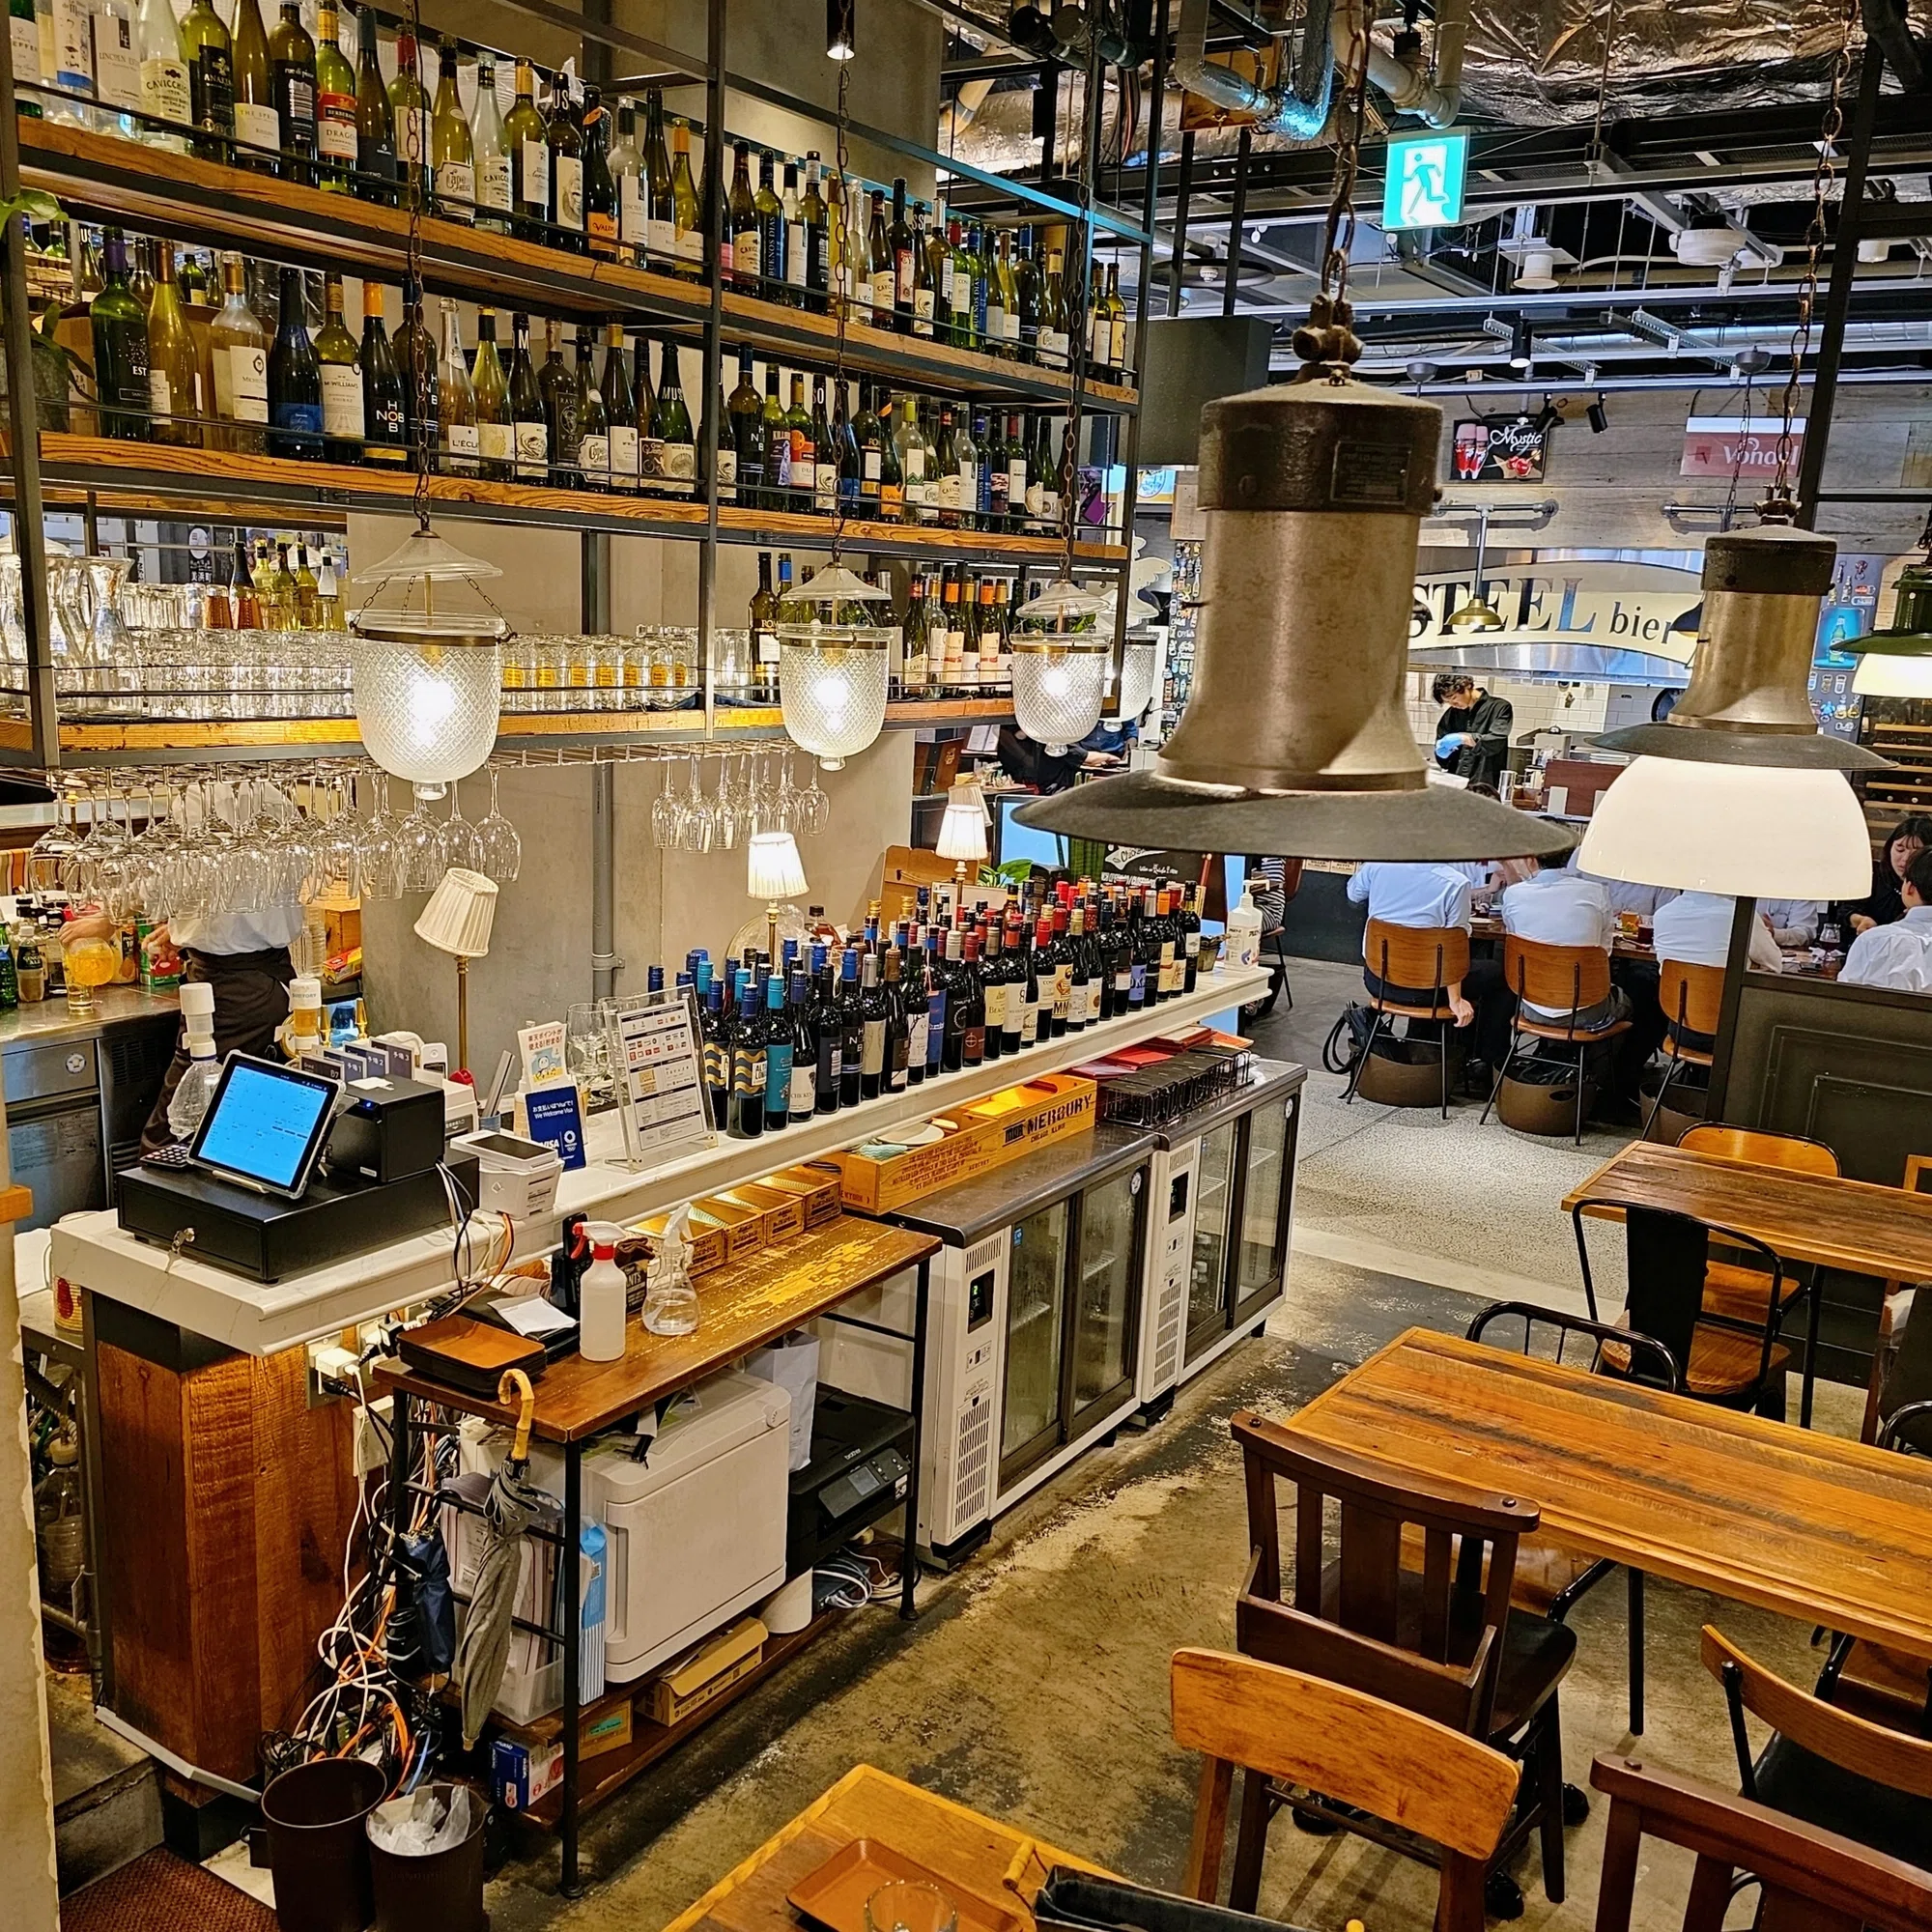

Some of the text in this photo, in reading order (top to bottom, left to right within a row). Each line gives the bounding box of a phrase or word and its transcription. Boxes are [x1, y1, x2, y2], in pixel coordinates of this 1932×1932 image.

[553, 88, 569, 111] US
[1490, 425, 1543, 452] Mystic
[543, 1109, 563, 1118] Welcome
[843, 1448, 862, 1461] brother
